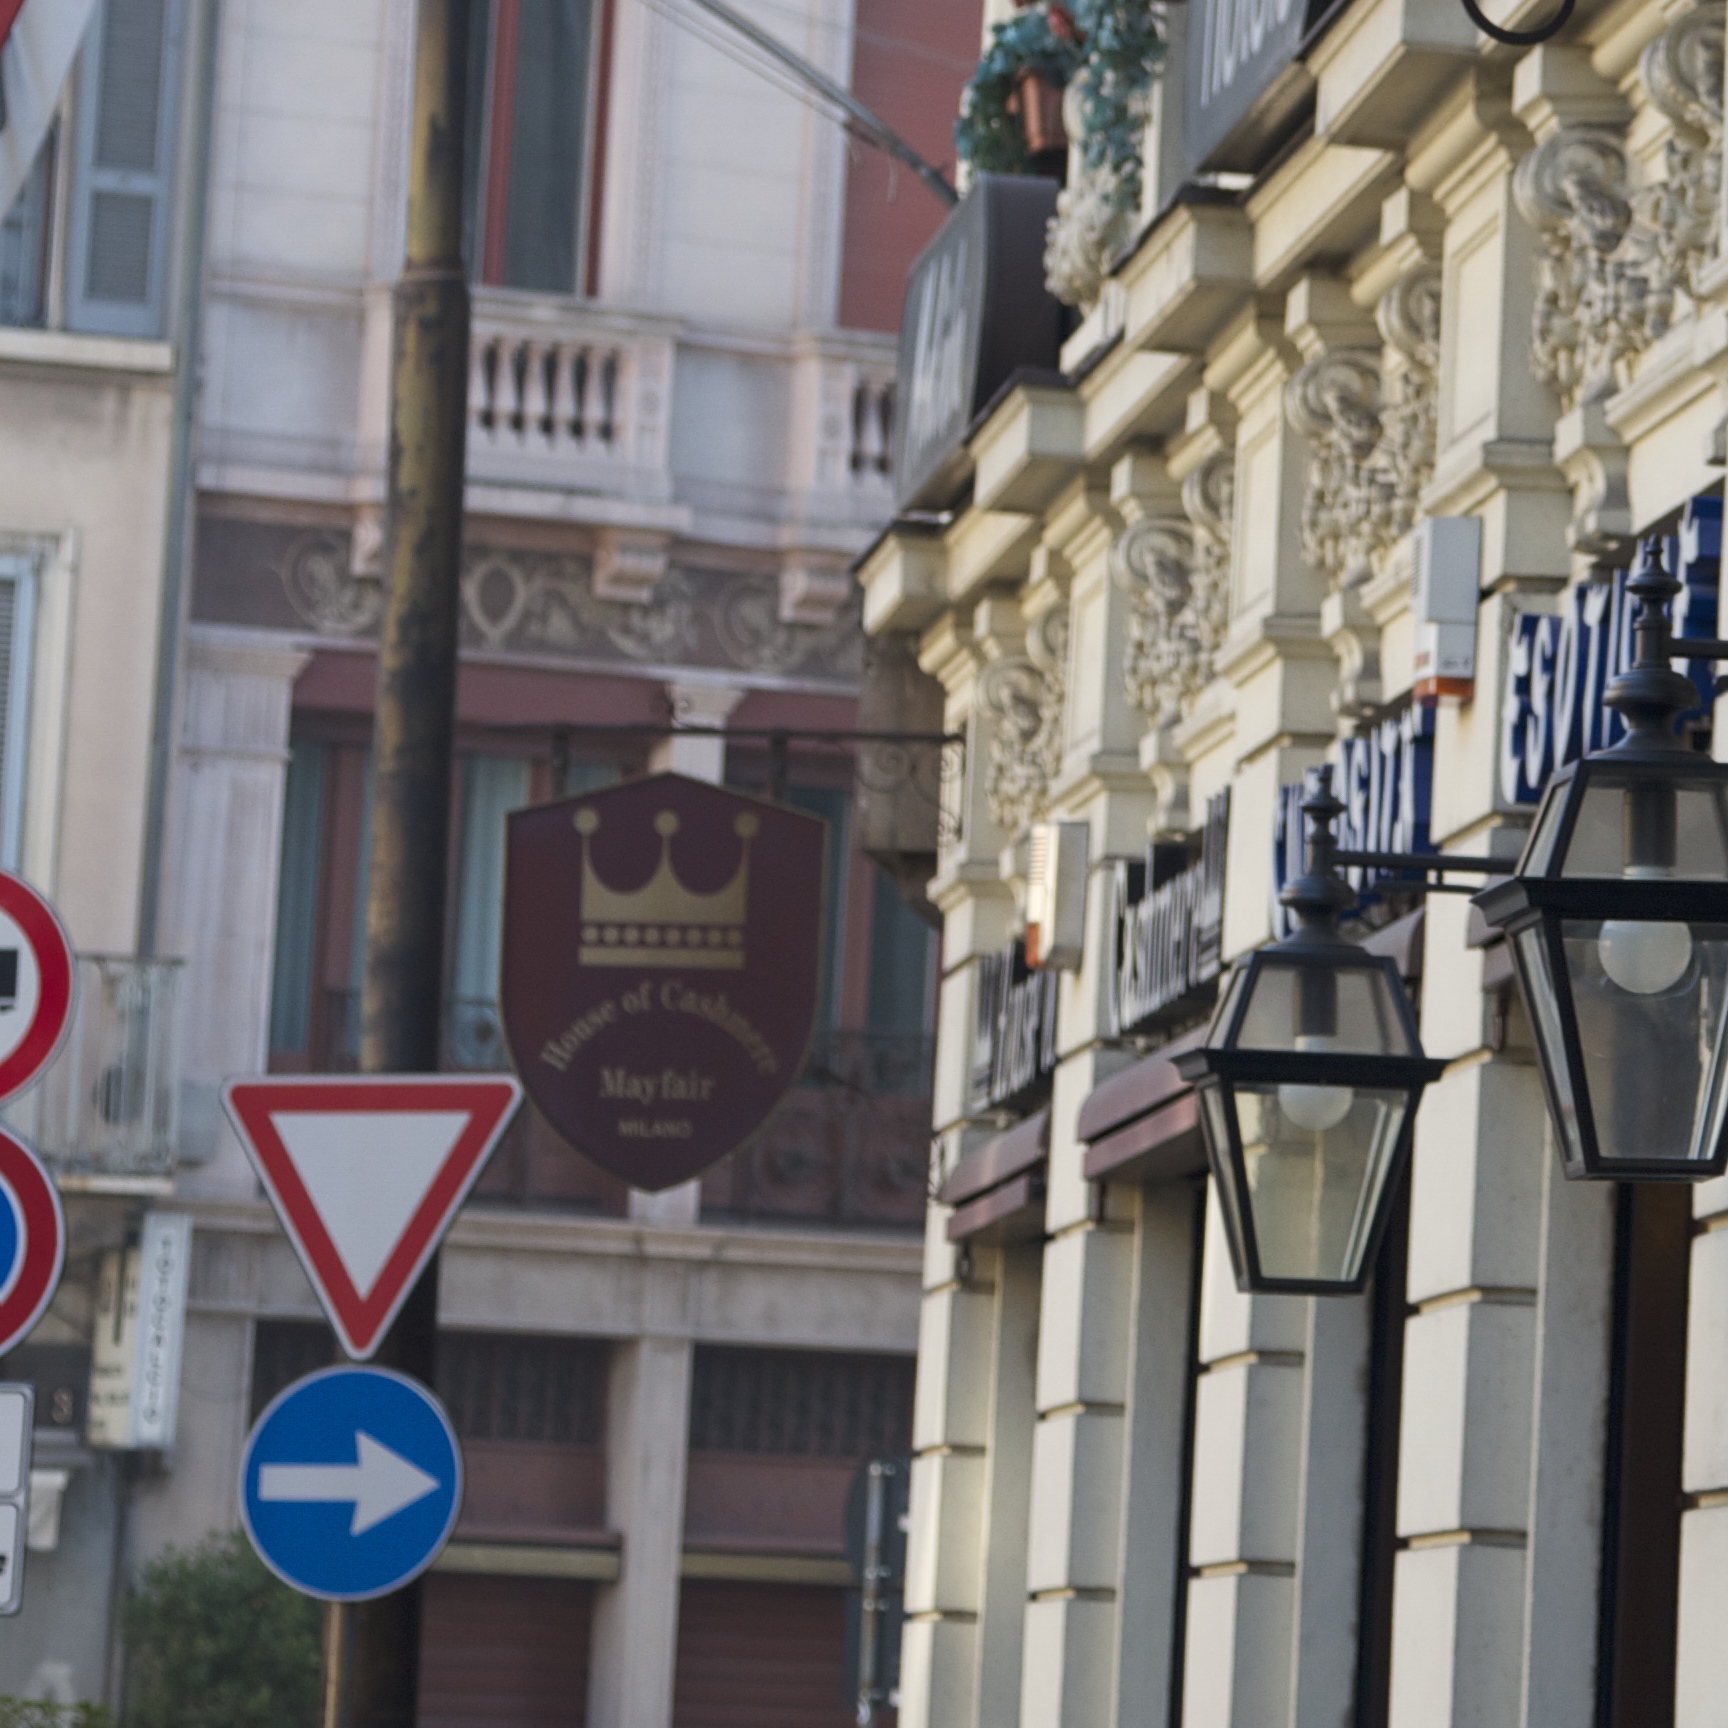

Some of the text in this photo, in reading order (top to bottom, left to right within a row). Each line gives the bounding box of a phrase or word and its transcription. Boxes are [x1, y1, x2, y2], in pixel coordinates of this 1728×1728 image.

[539, 997, 618, 1072] House
[621, 980, 653, 1015] of
[600, 1066, 716, 1105] Mayfair
[617, 1118, 695, 1140] MILANO
